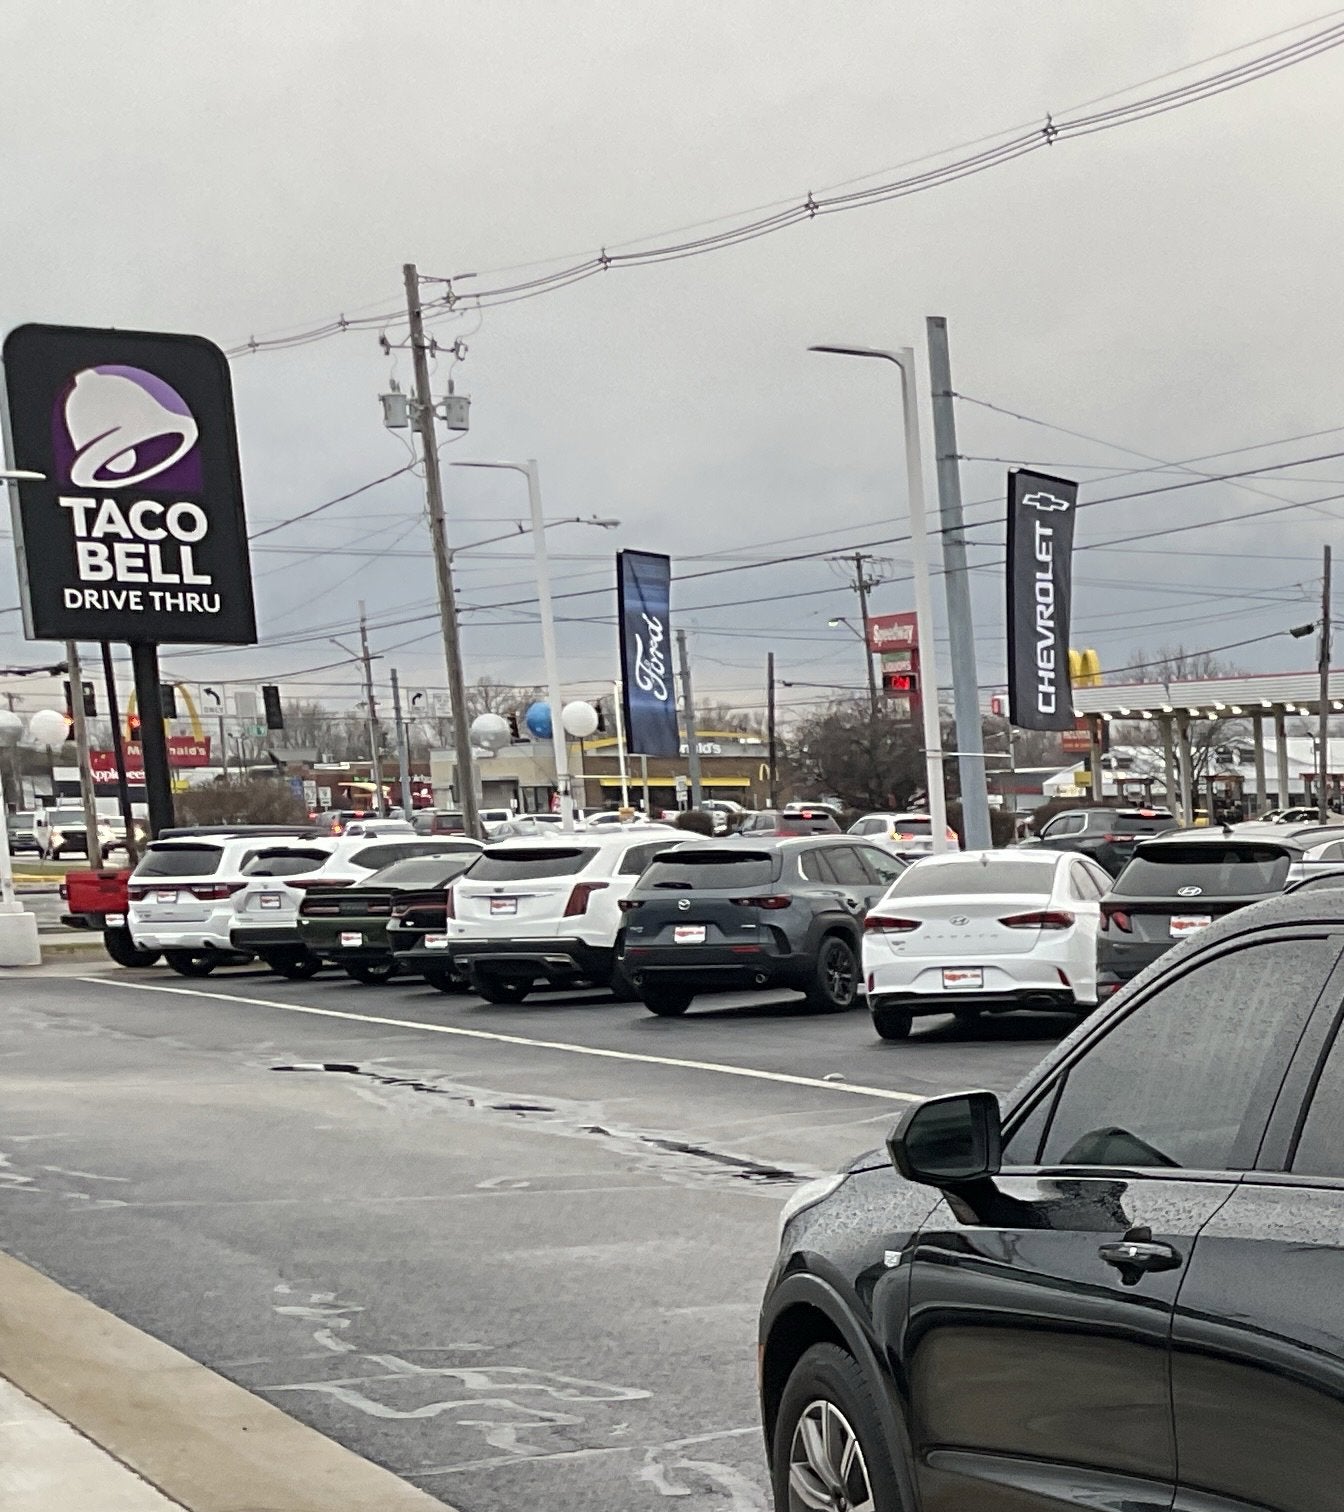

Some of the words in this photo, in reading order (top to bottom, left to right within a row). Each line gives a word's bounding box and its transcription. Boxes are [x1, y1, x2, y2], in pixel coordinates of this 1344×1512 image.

[59, 496, 208, 542] TACO
[76, 540, 212, 585] BELL
[64, 588, 145, 611] DRIVE
[149, 591, 221, 613] THRU
[1033, 520, 1057, 715] CHEVROLET
[635, 612, 668, 702] Ford
